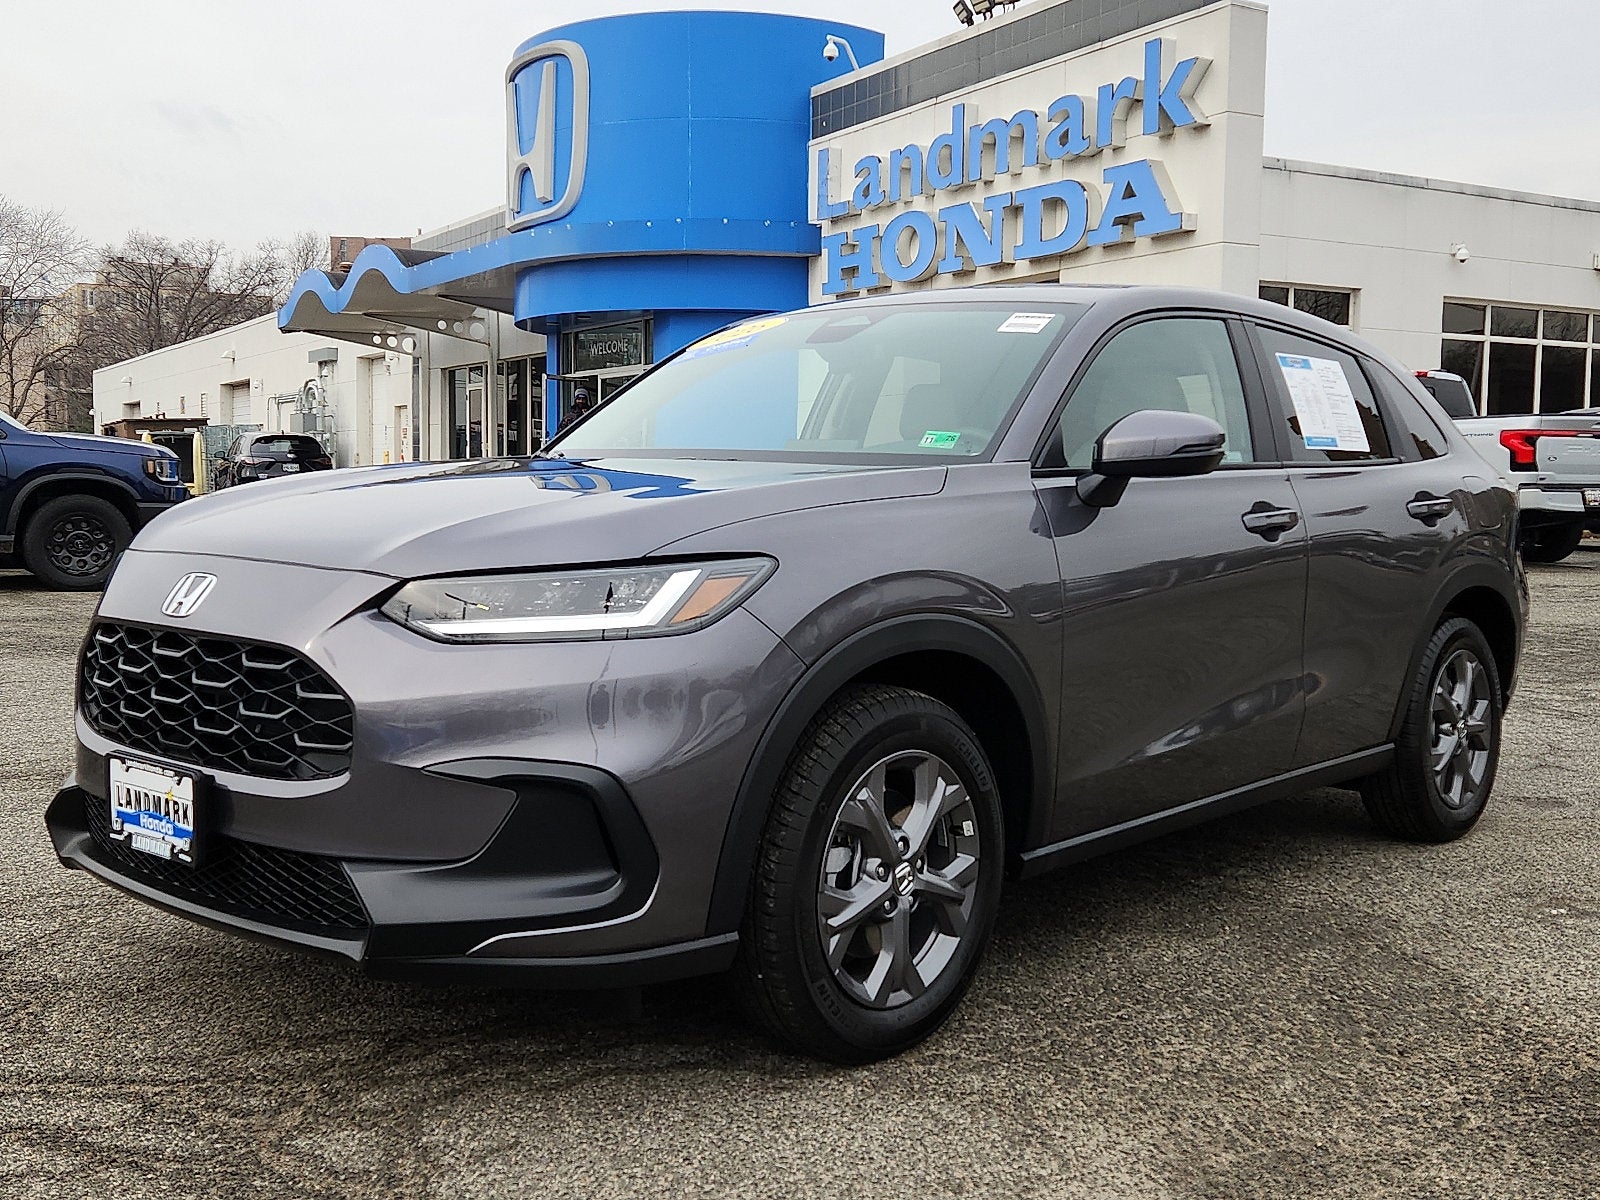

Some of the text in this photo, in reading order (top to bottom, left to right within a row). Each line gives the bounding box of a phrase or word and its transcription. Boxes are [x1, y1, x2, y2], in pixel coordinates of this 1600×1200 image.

[816, 37, 1206, 222] Landmark
[822, 158, 1188, 297] HONDA
[590, 338, 629, 356] WELCOME
[115, 784, 191, 827] LANDMARK
[139, 813, 175, 836] Honda
